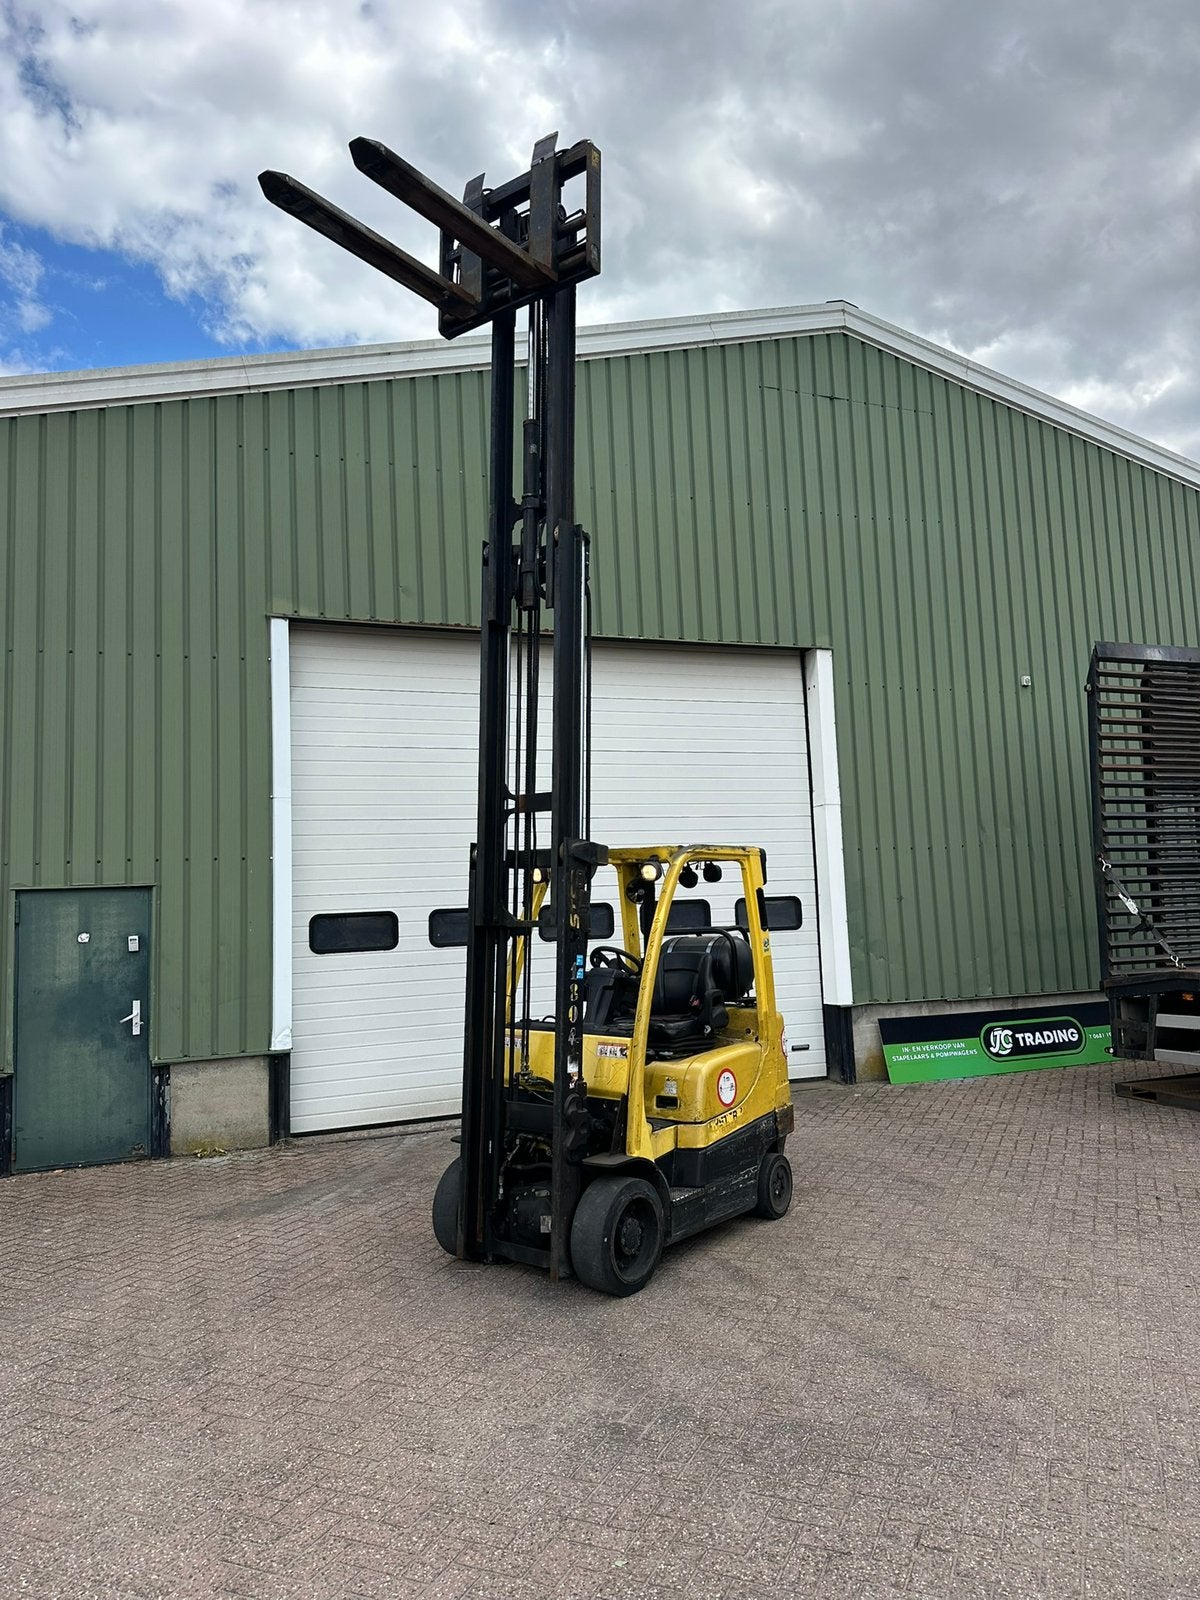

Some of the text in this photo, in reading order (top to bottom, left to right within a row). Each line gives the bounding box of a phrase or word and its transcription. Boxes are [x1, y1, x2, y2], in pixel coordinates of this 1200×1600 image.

[1015, 1028, 1079, 1047] TRADING
[921, 1043, 952, 1052] VERKOOP
[952, 1041, 966, 1049] VAN
[891, 1053, 930, 1062] STAPELAARS
[935, 1049, 978, 1058] POMPWAGENS
